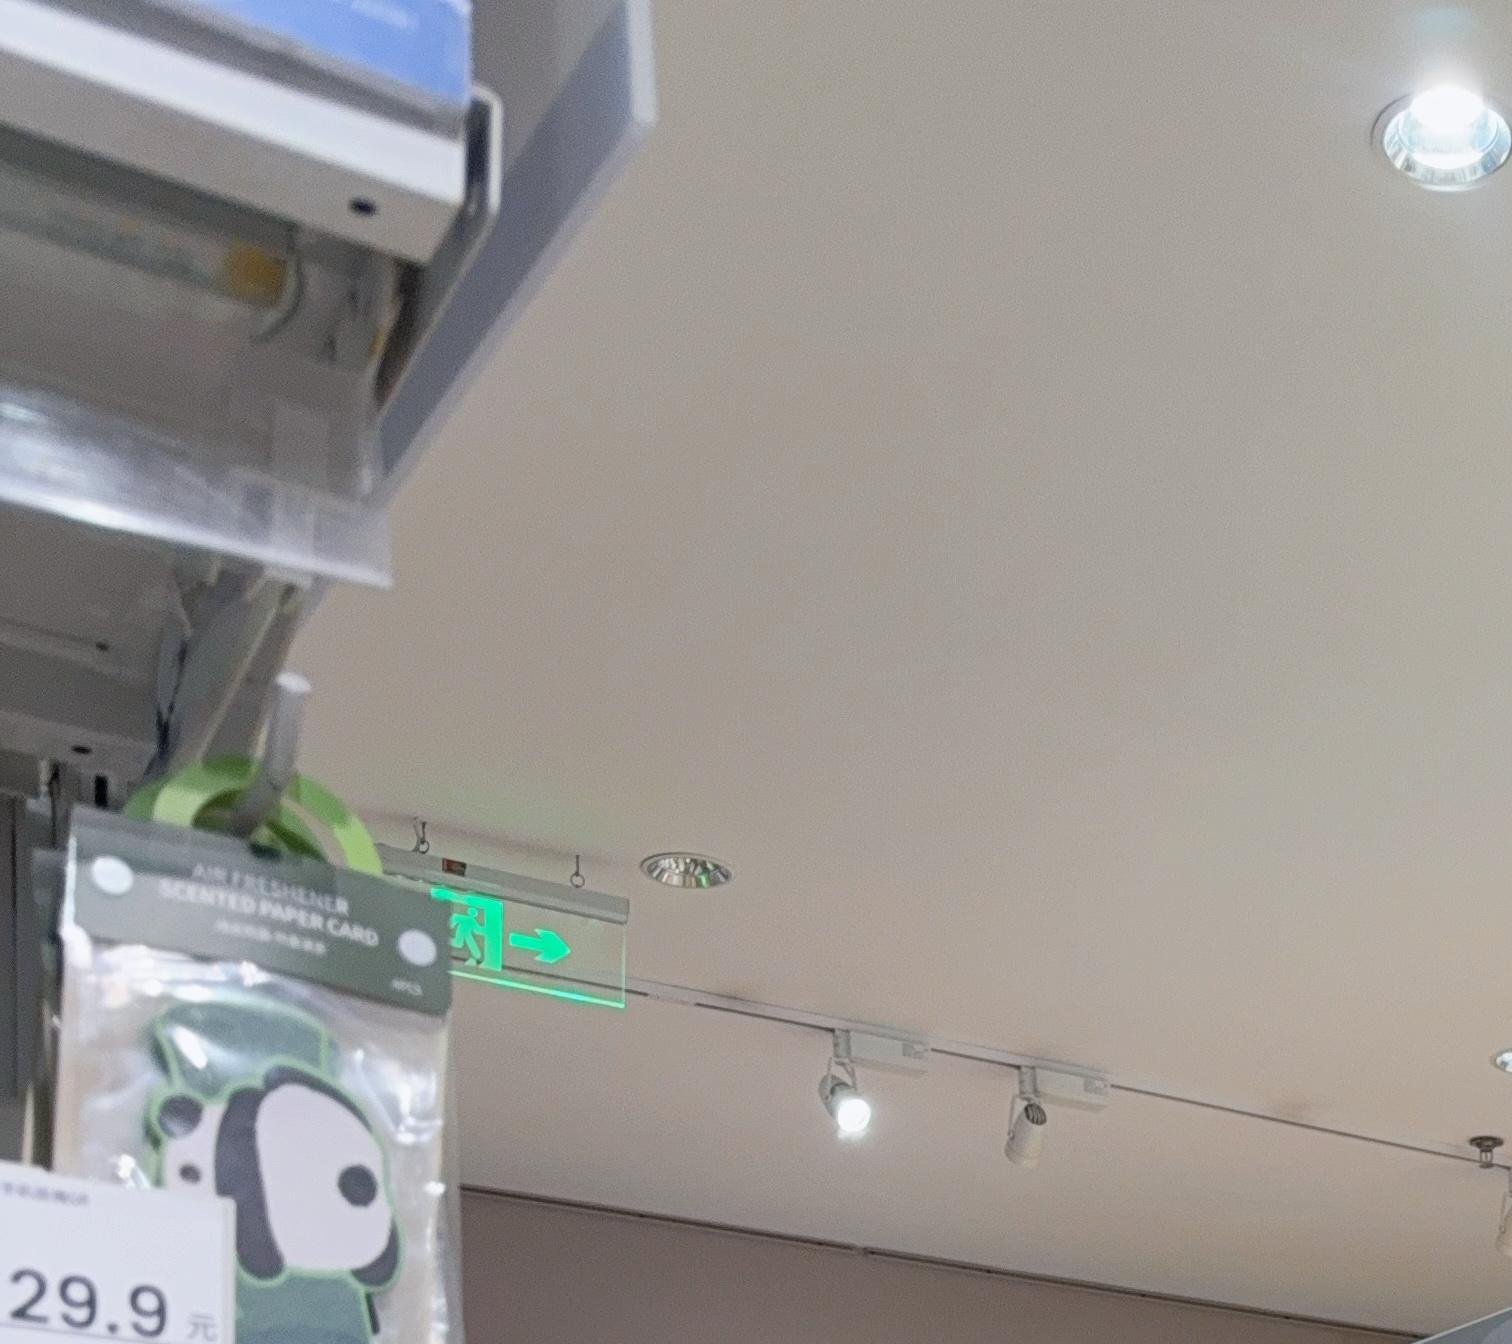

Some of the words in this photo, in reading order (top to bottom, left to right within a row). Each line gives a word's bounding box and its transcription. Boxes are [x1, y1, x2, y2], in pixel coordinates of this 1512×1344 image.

[158, 878, 256, 915] SCENTED
[258, 899, 325, 930] PAPER
[327, 916, 380, 947] CARD
[231, 870, 350, 916] FRESHENER
[10, 1268, 168, 1338] 29.9
[187, 1313, 219, 1342] 元
